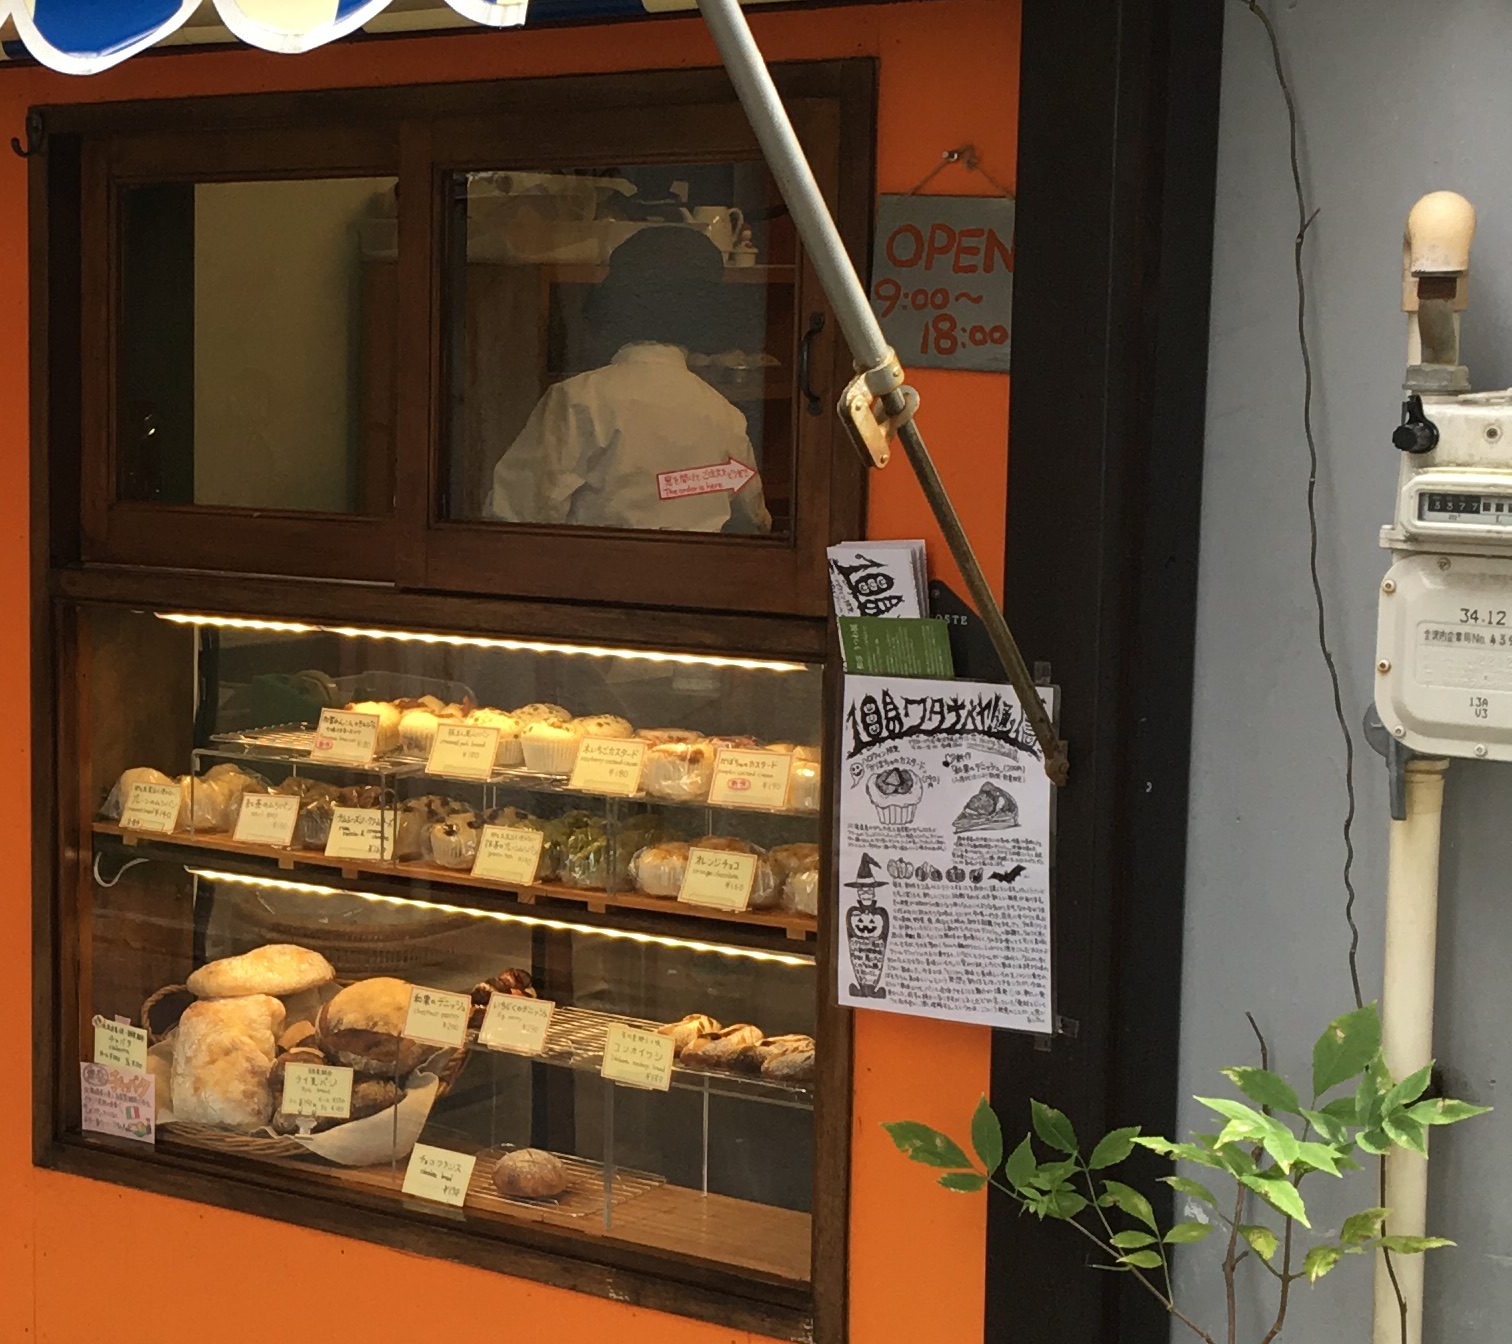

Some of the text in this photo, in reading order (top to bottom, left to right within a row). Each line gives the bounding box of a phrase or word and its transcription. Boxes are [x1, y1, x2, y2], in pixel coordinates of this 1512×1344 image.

[886, 224, 1014, 274] OPEN
[919, 314, 1009, 356] 18:00
[1469, 697, 1488, 707] 13A
[695, 855, 740, 870] オレンジチョコ
